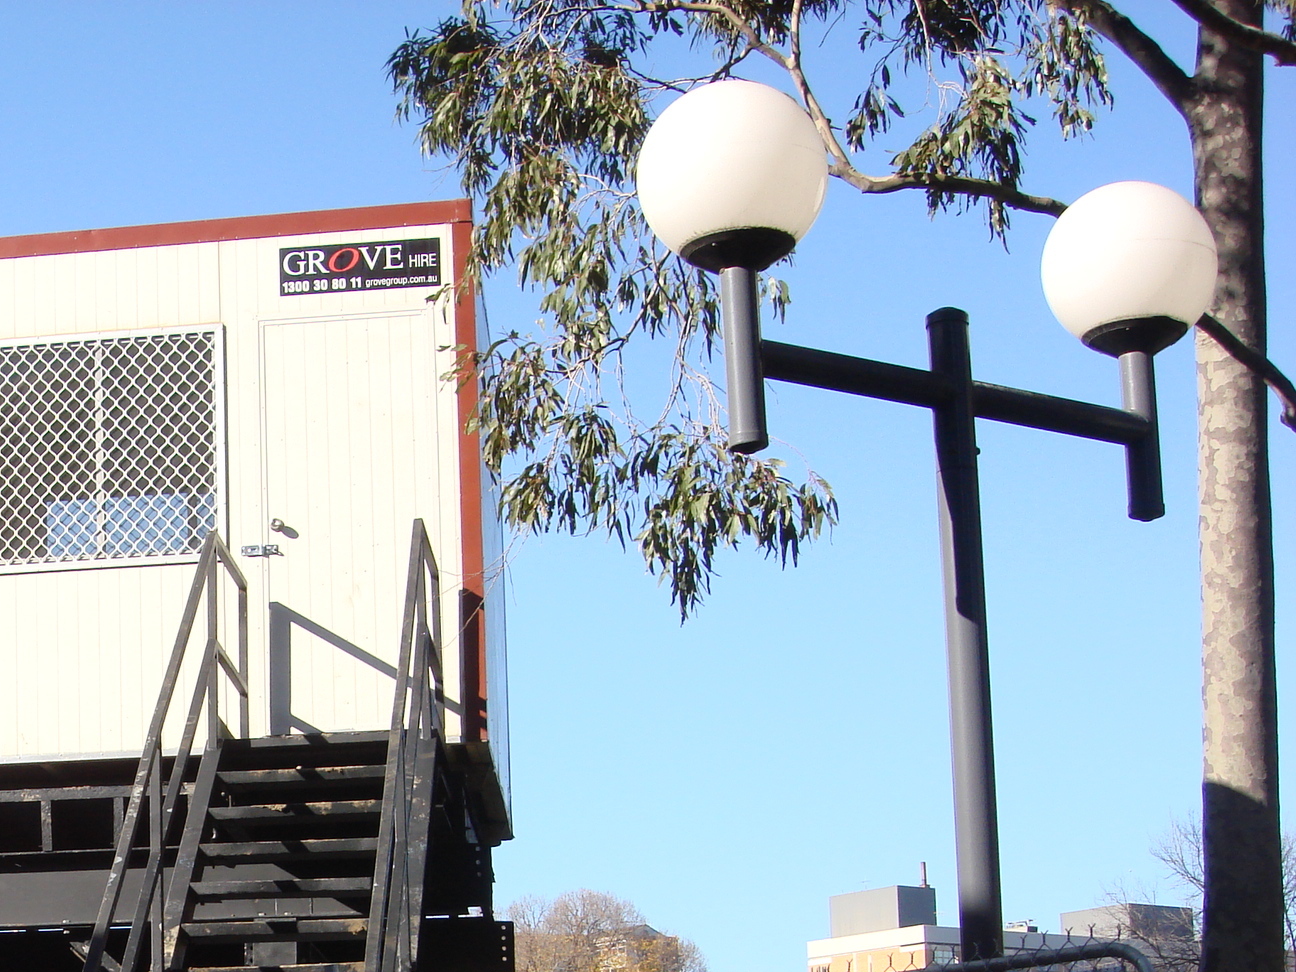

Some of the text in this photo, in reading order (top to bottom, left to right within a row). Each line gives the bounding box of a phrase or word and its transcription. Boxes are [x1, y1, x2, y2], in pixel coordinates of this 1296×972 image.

[283, 244, 437, 275] GROVE HIRE
[282, 274, 438, 293] 1300 30 80 11 grovegroup.com.au
